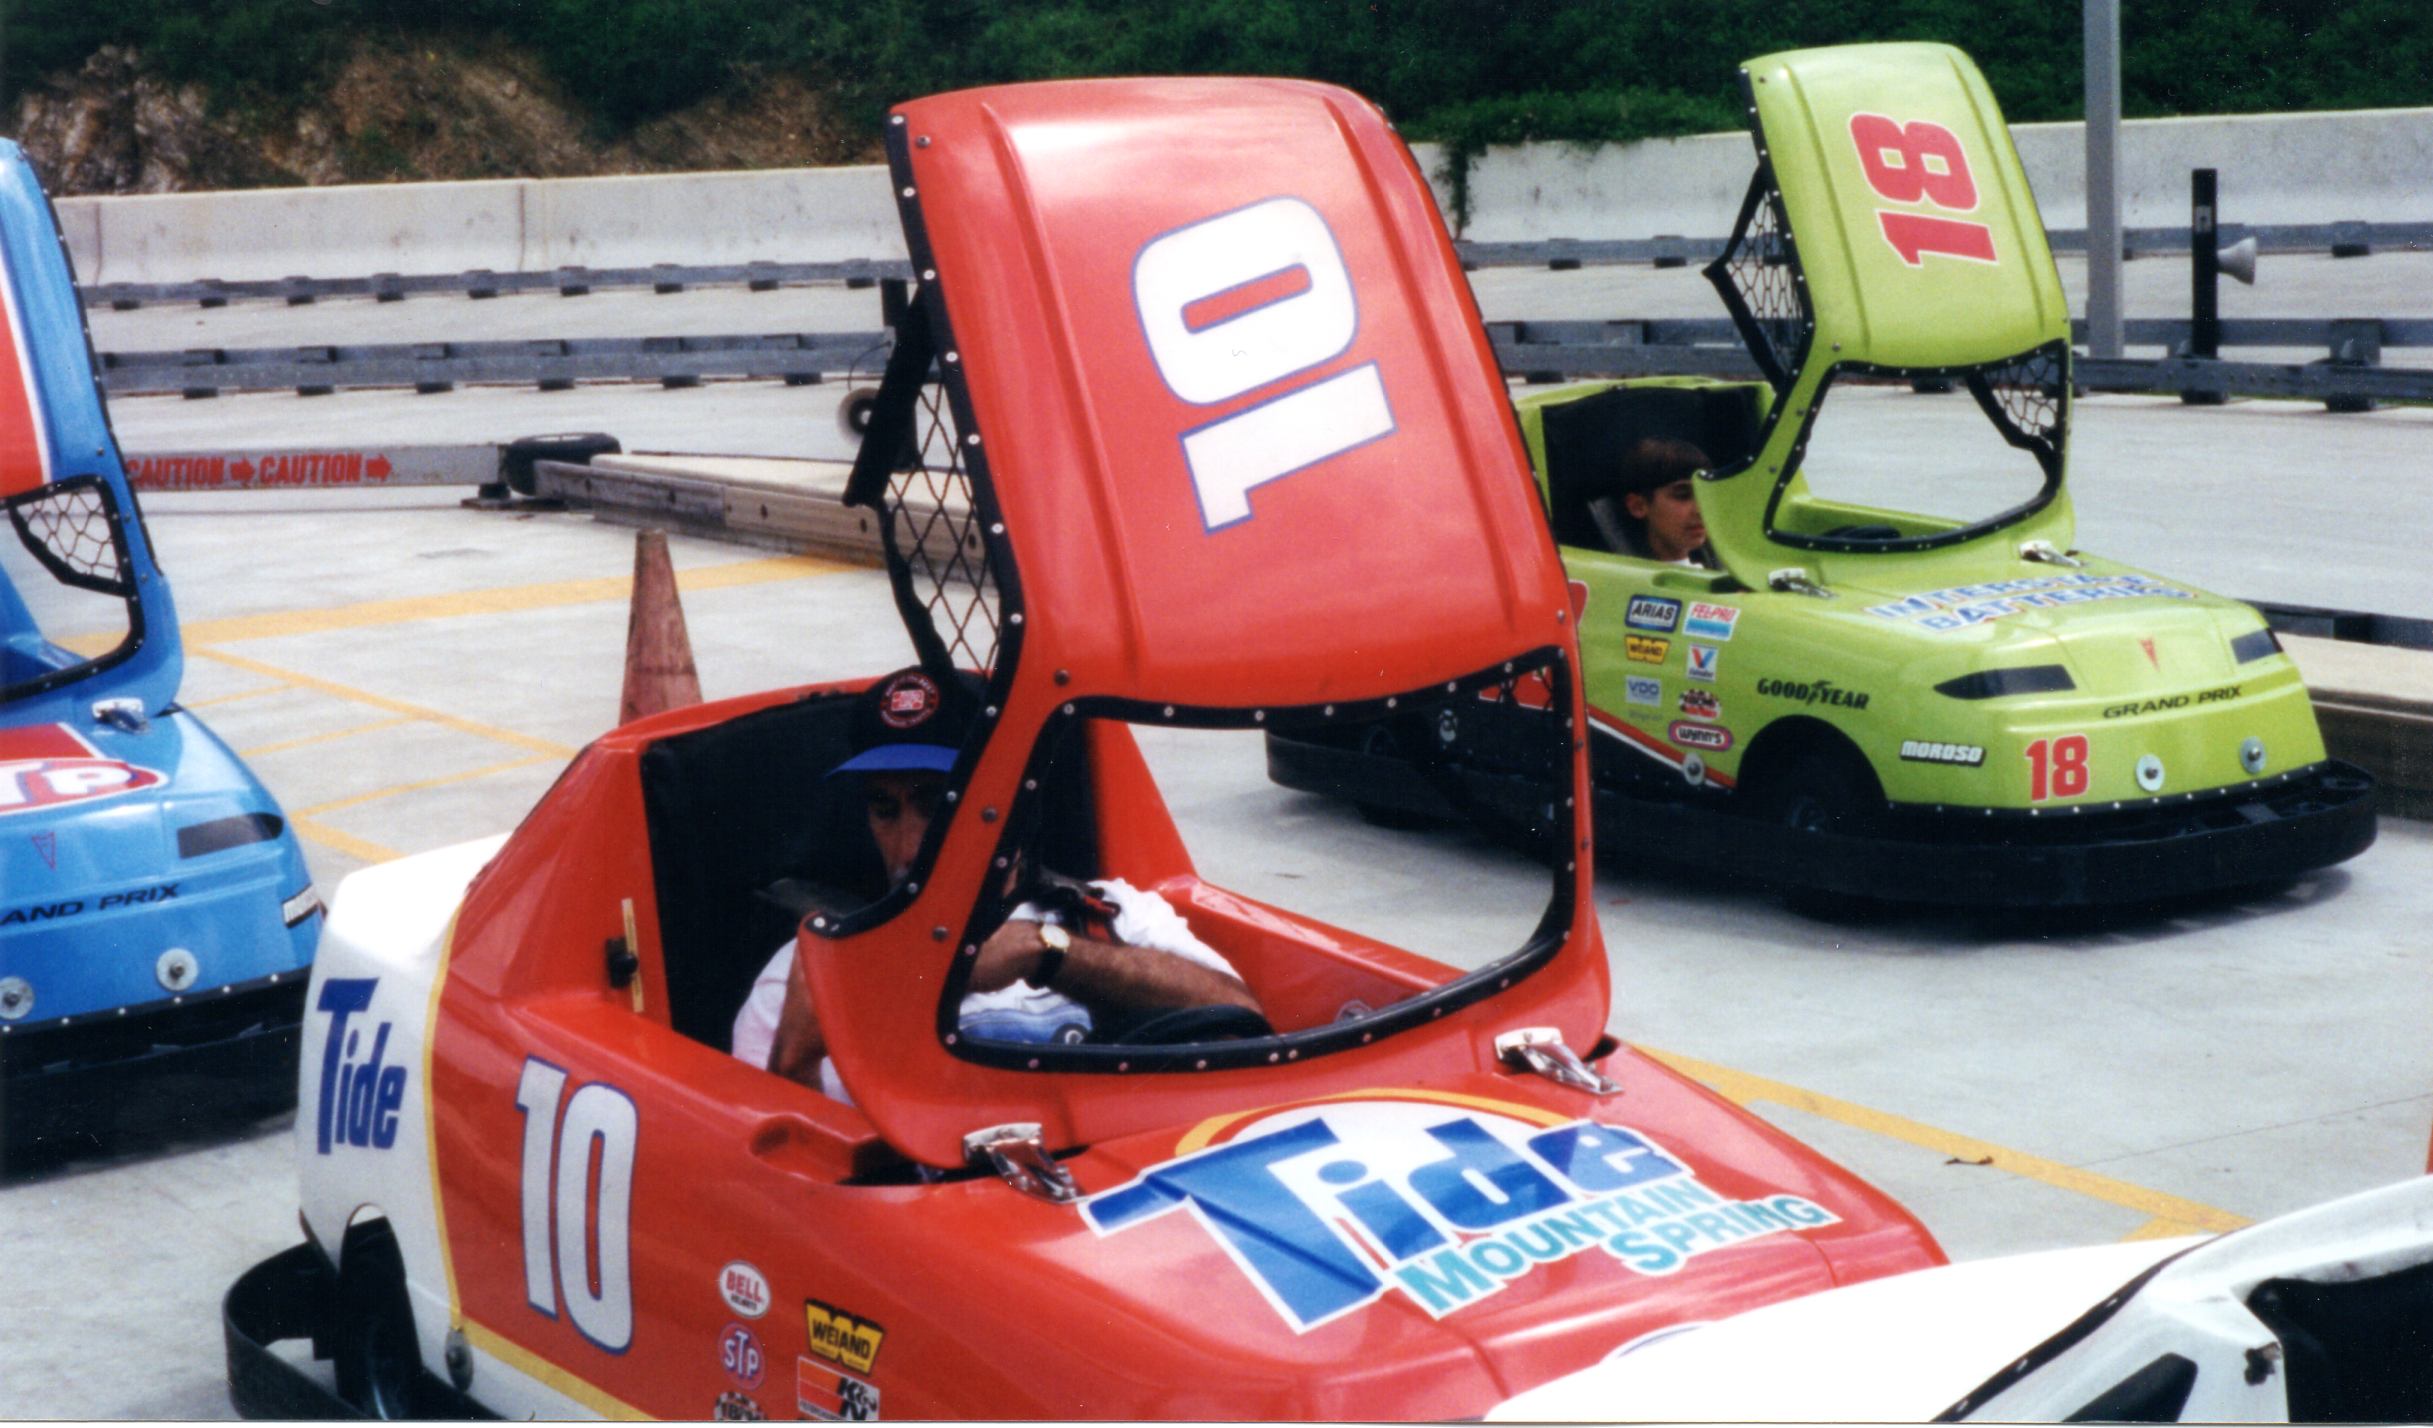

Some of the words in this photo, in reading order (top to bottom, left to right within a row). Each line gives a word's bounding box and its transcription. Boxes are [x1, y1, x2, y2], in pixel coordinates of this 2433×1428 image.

[1849, 113, 1999, 267] 18
[1130, 194, 1398, 536] 10
[126, 456, 225, 487] CAUTION
[259, 453, 362, 485] CAUTION
[1632, 603, 1674, 621] ARIAS
[1628, 680, 1659, 696] VDO
[1757, 677, 1869, 709] GOODYEAR
[2103, 695, 2189, 719] GRAND
[2197, 684, 2242, 704] PRIX
[2026, 735, 2089, 802] 18
[100, 882, 179, 910] PRIX
[317, 977, 407, 1154] Tide
[515, 1053, 638, 1355] 10
[1086, 1117, 1690, 1327] Tide
[1394, 1178, 1722, 1304] MOUNTAIN
[1608, 1197, 1832, 1273] SPRING
[726, 1269, 761, 1304] BELL
[725, 1330, 759, 1378] STP
[812, 1318, 872, 1360] WEIAND
